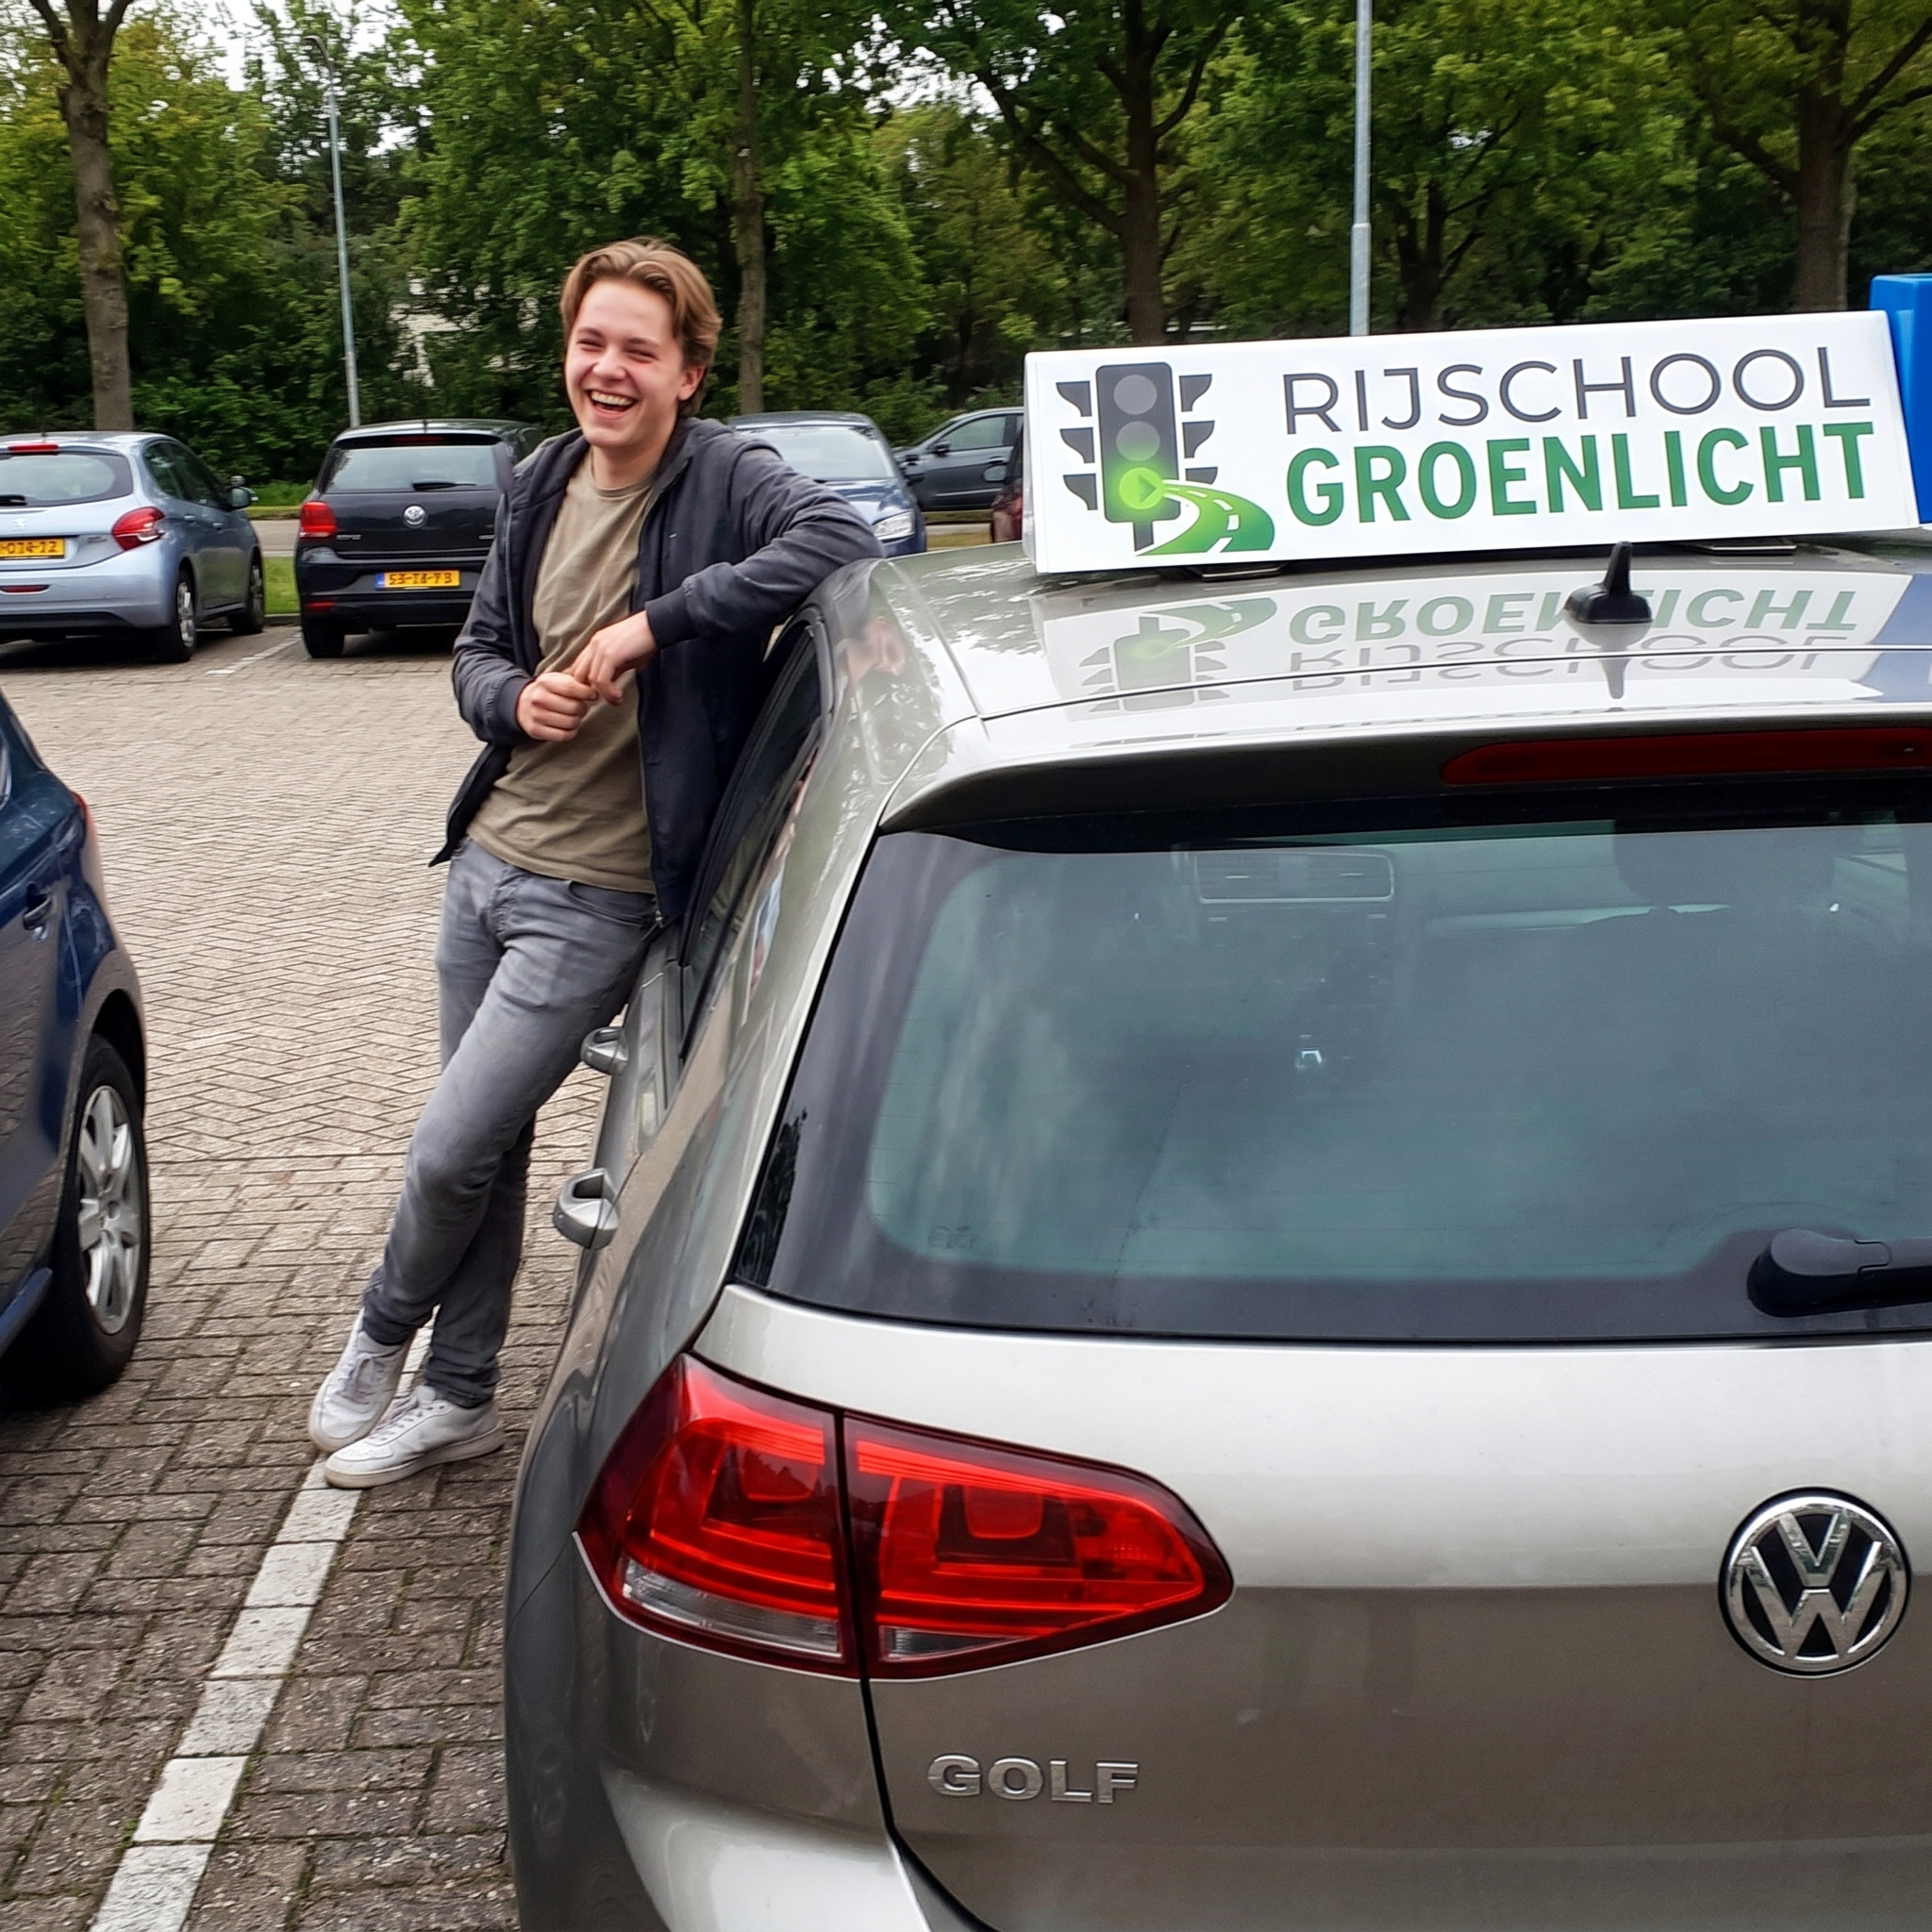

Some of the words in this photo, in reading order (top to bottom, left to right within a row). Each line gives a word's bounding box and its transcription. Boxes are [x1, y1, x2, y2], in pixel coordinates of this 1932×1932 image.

[1284, 346, 1872, 436] RIJSCHOOL
[1287, 420, 1875, 526] GROENLICHT
[1729, 1492, 1901, 1669] VW
[927, 1753, 1141, 1805] GOLF
